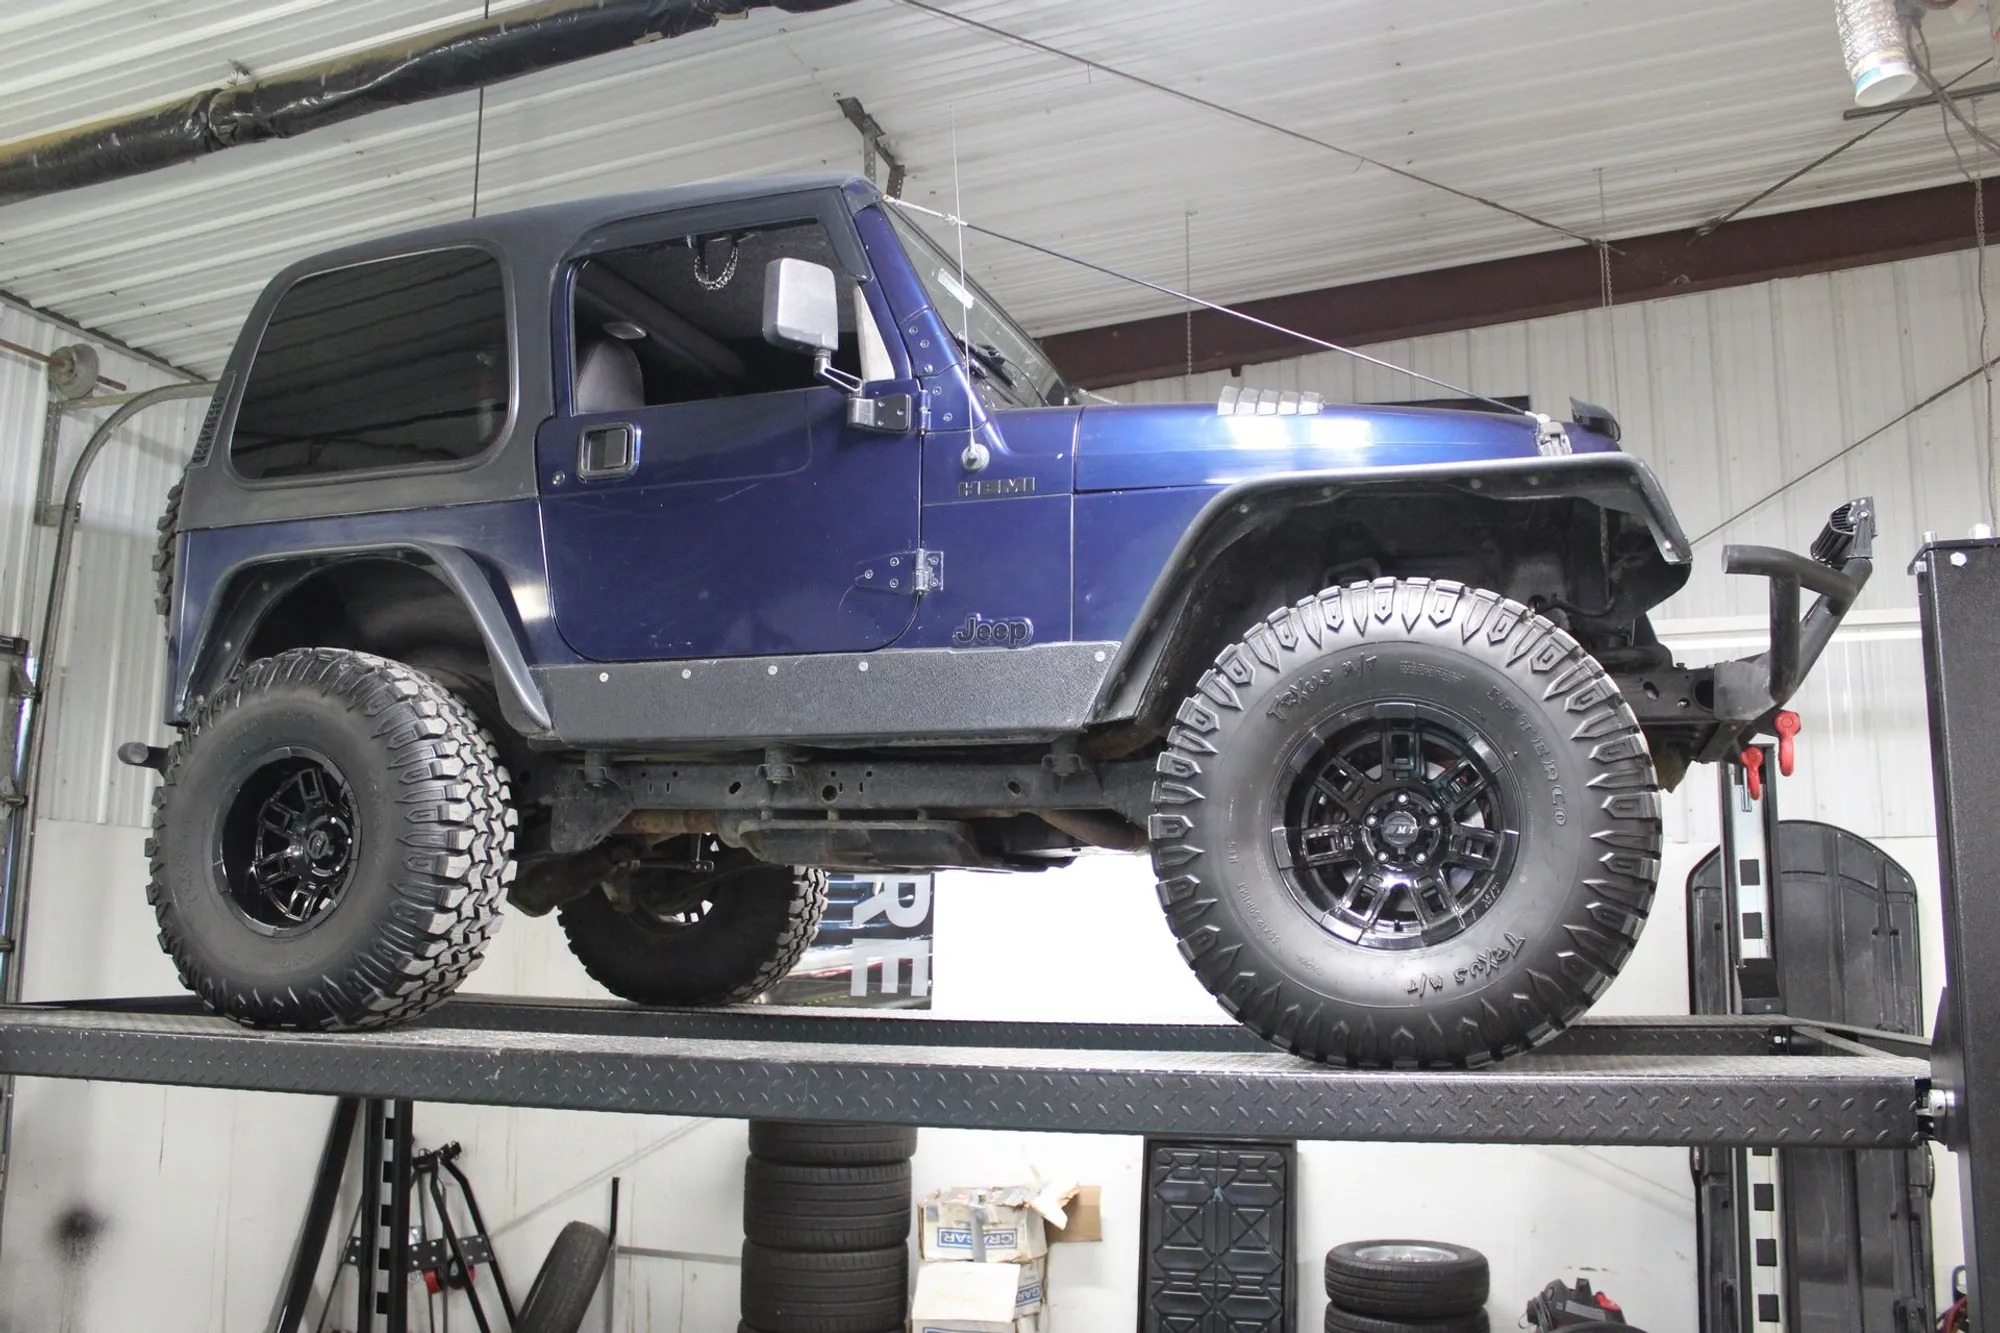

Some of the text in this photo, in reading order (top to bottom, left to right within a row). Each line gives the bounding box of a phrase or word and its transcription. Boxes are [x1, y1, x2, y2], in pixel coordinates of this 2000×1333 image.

[956, 617, 1029, 646] Jeep
[1396, 825, 1416, 835] M/T
[1406, 971, 1444, 998] M/T
